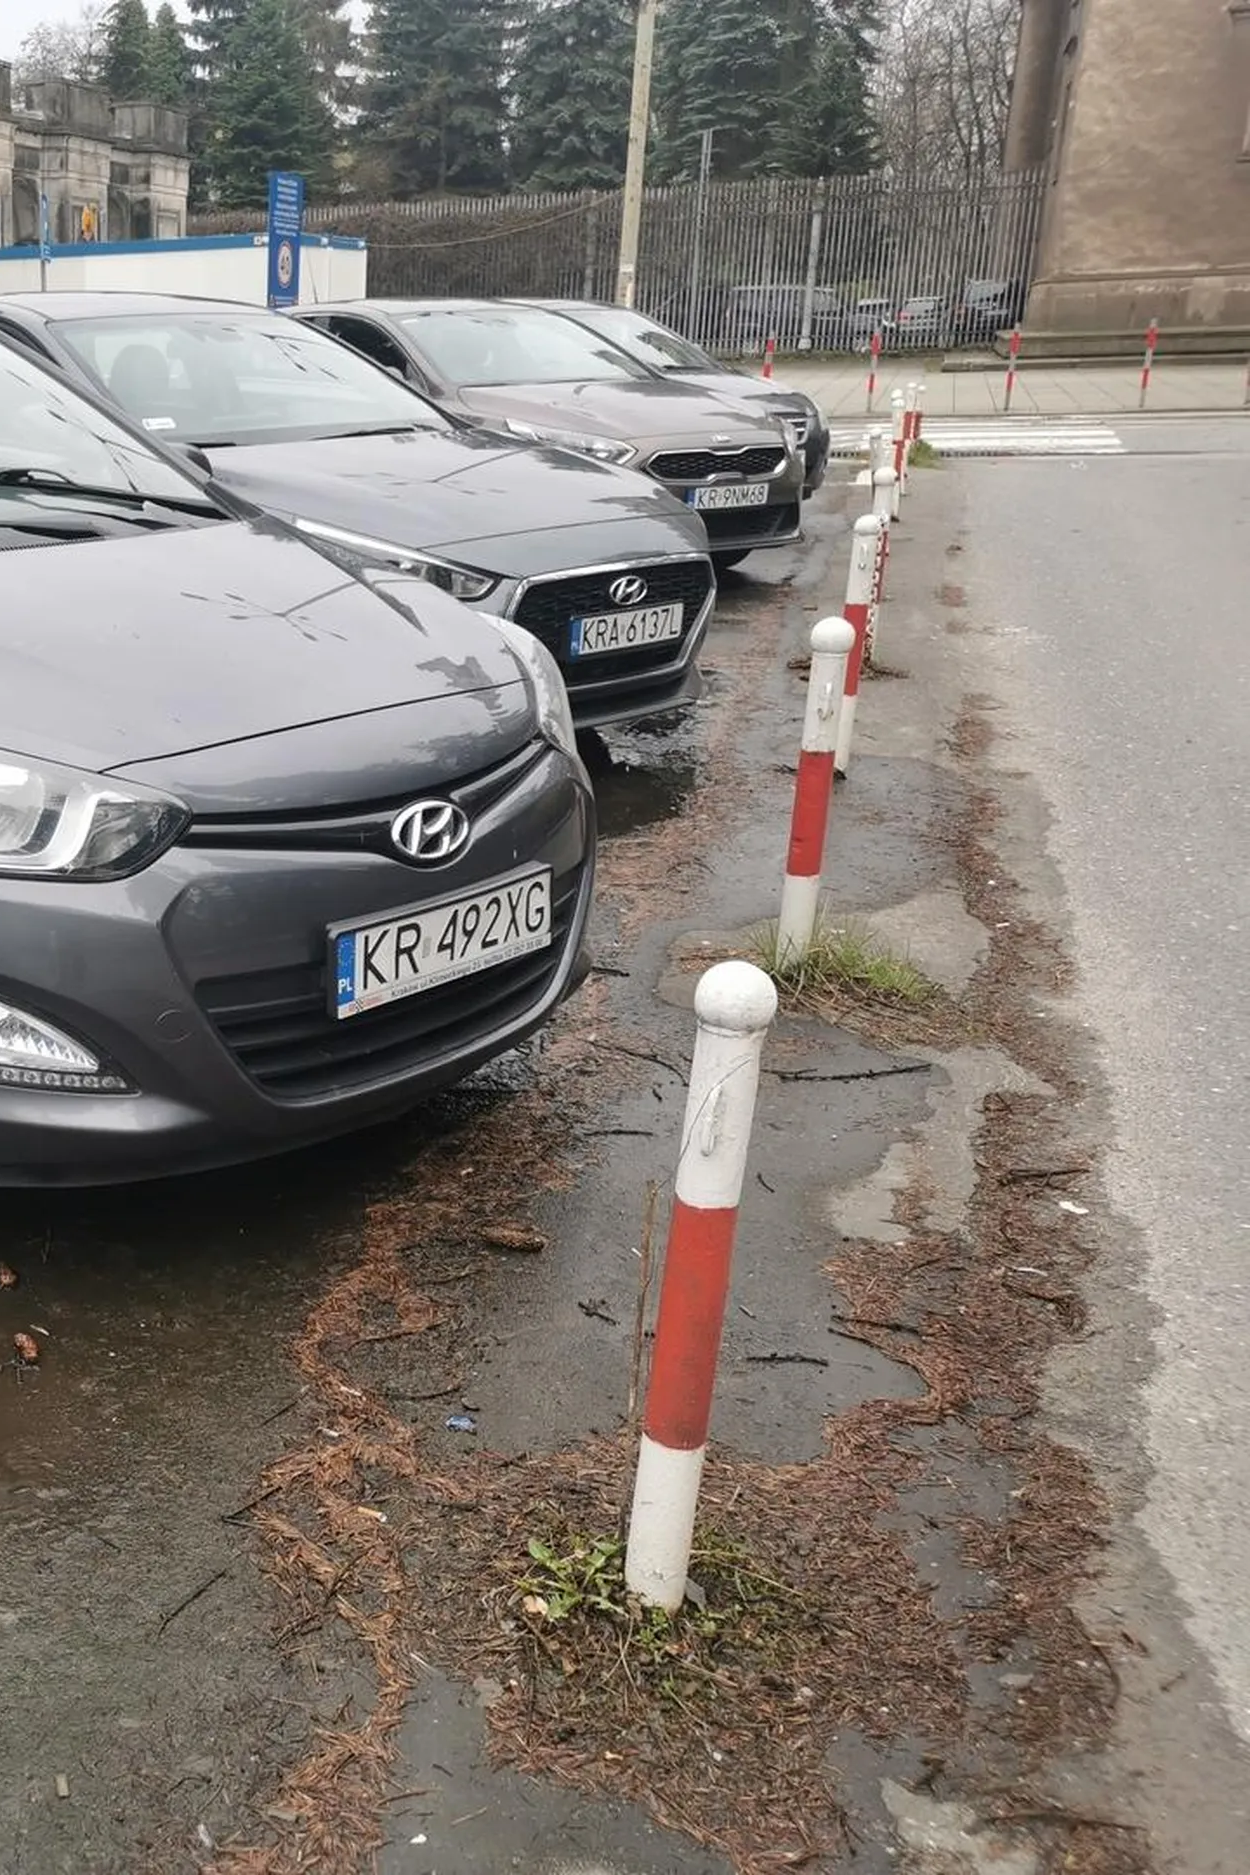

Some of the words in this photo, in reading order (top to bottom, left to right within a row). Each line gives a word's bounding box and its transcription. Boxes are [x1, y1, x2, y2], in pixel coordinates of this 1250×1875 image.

[697, 488, 717, 507] KR
[723, 484, 765, 505] 9NM68
[582, 617, 619, 651] KRA
[626, 605, 678, 642] 6137L
[338, 976, 353, 995] PL
[363, 922, 422, 990] KR
[437, 881, 545, 961] 492XG
